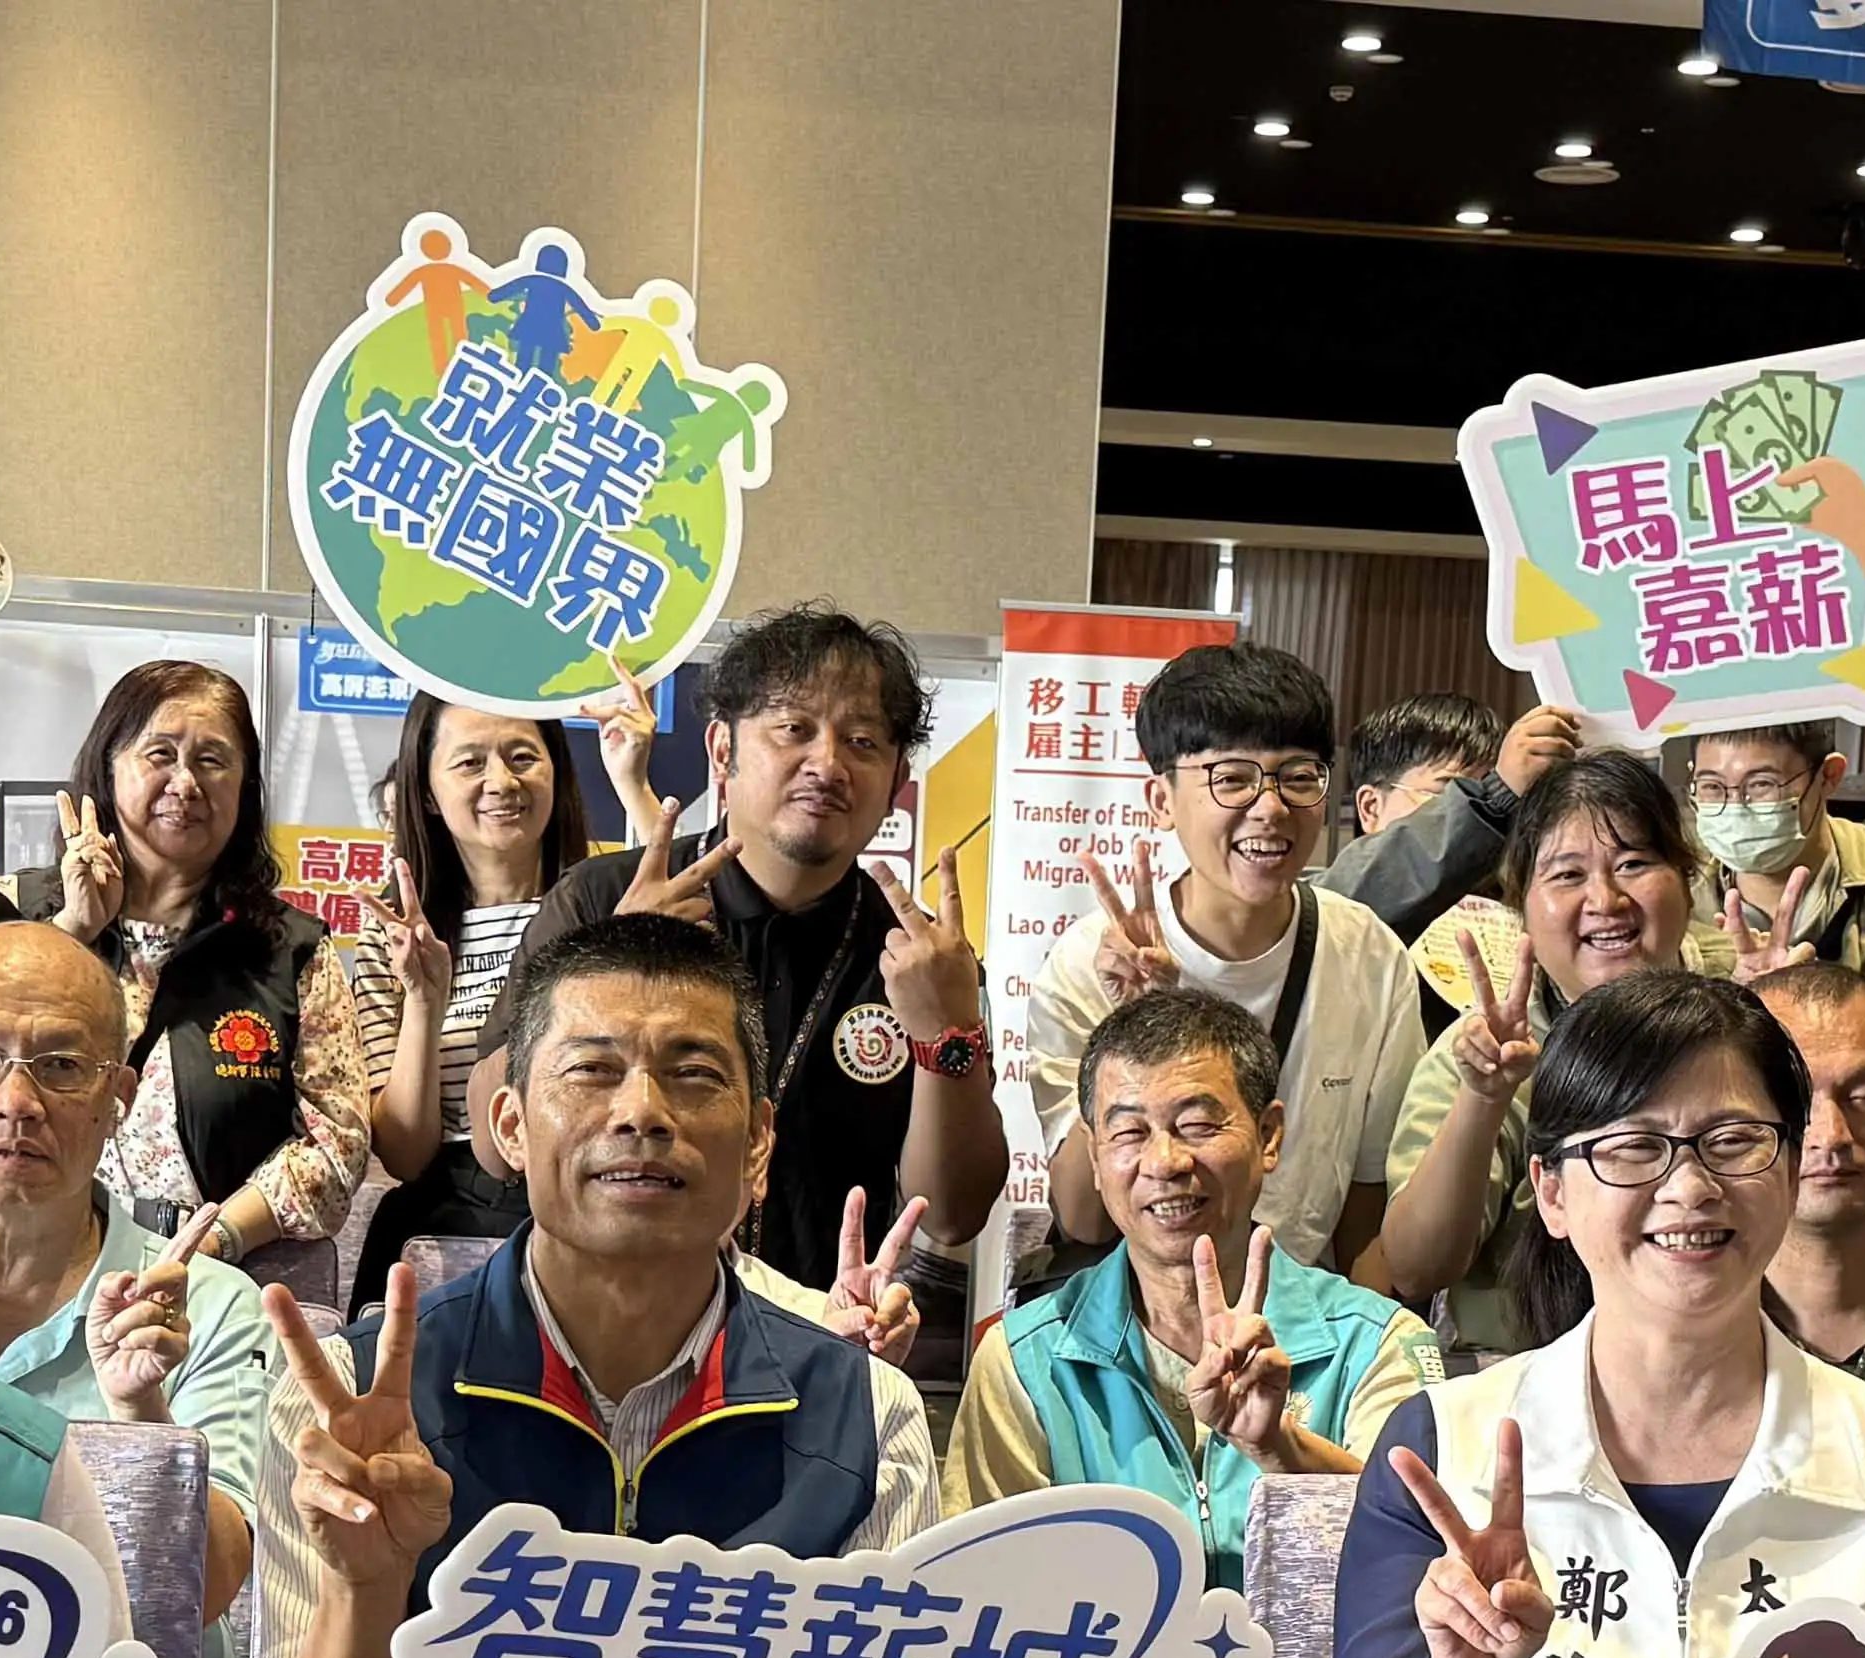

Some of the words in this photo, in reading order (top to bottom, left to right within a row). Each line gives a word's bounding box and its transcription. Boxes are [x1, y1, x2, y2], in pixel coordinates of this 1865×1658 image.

[426, 346, 662, 526] 就業
[325, 416, 664, 649] 無國界
[1572, 450, 1788, 570] 馬上
[1634, 545, 1848, 674] 嘉薪
[1013, 800, 1092, 825] Transfer
[1095, 803, 1115, 826] of
[1059, 836, 1082, 853] or
[1087, 833, 1124, 855] Job
[1008, 913, 1045, 936] Lao
[1739, 1557, 1785, 1613] 太
